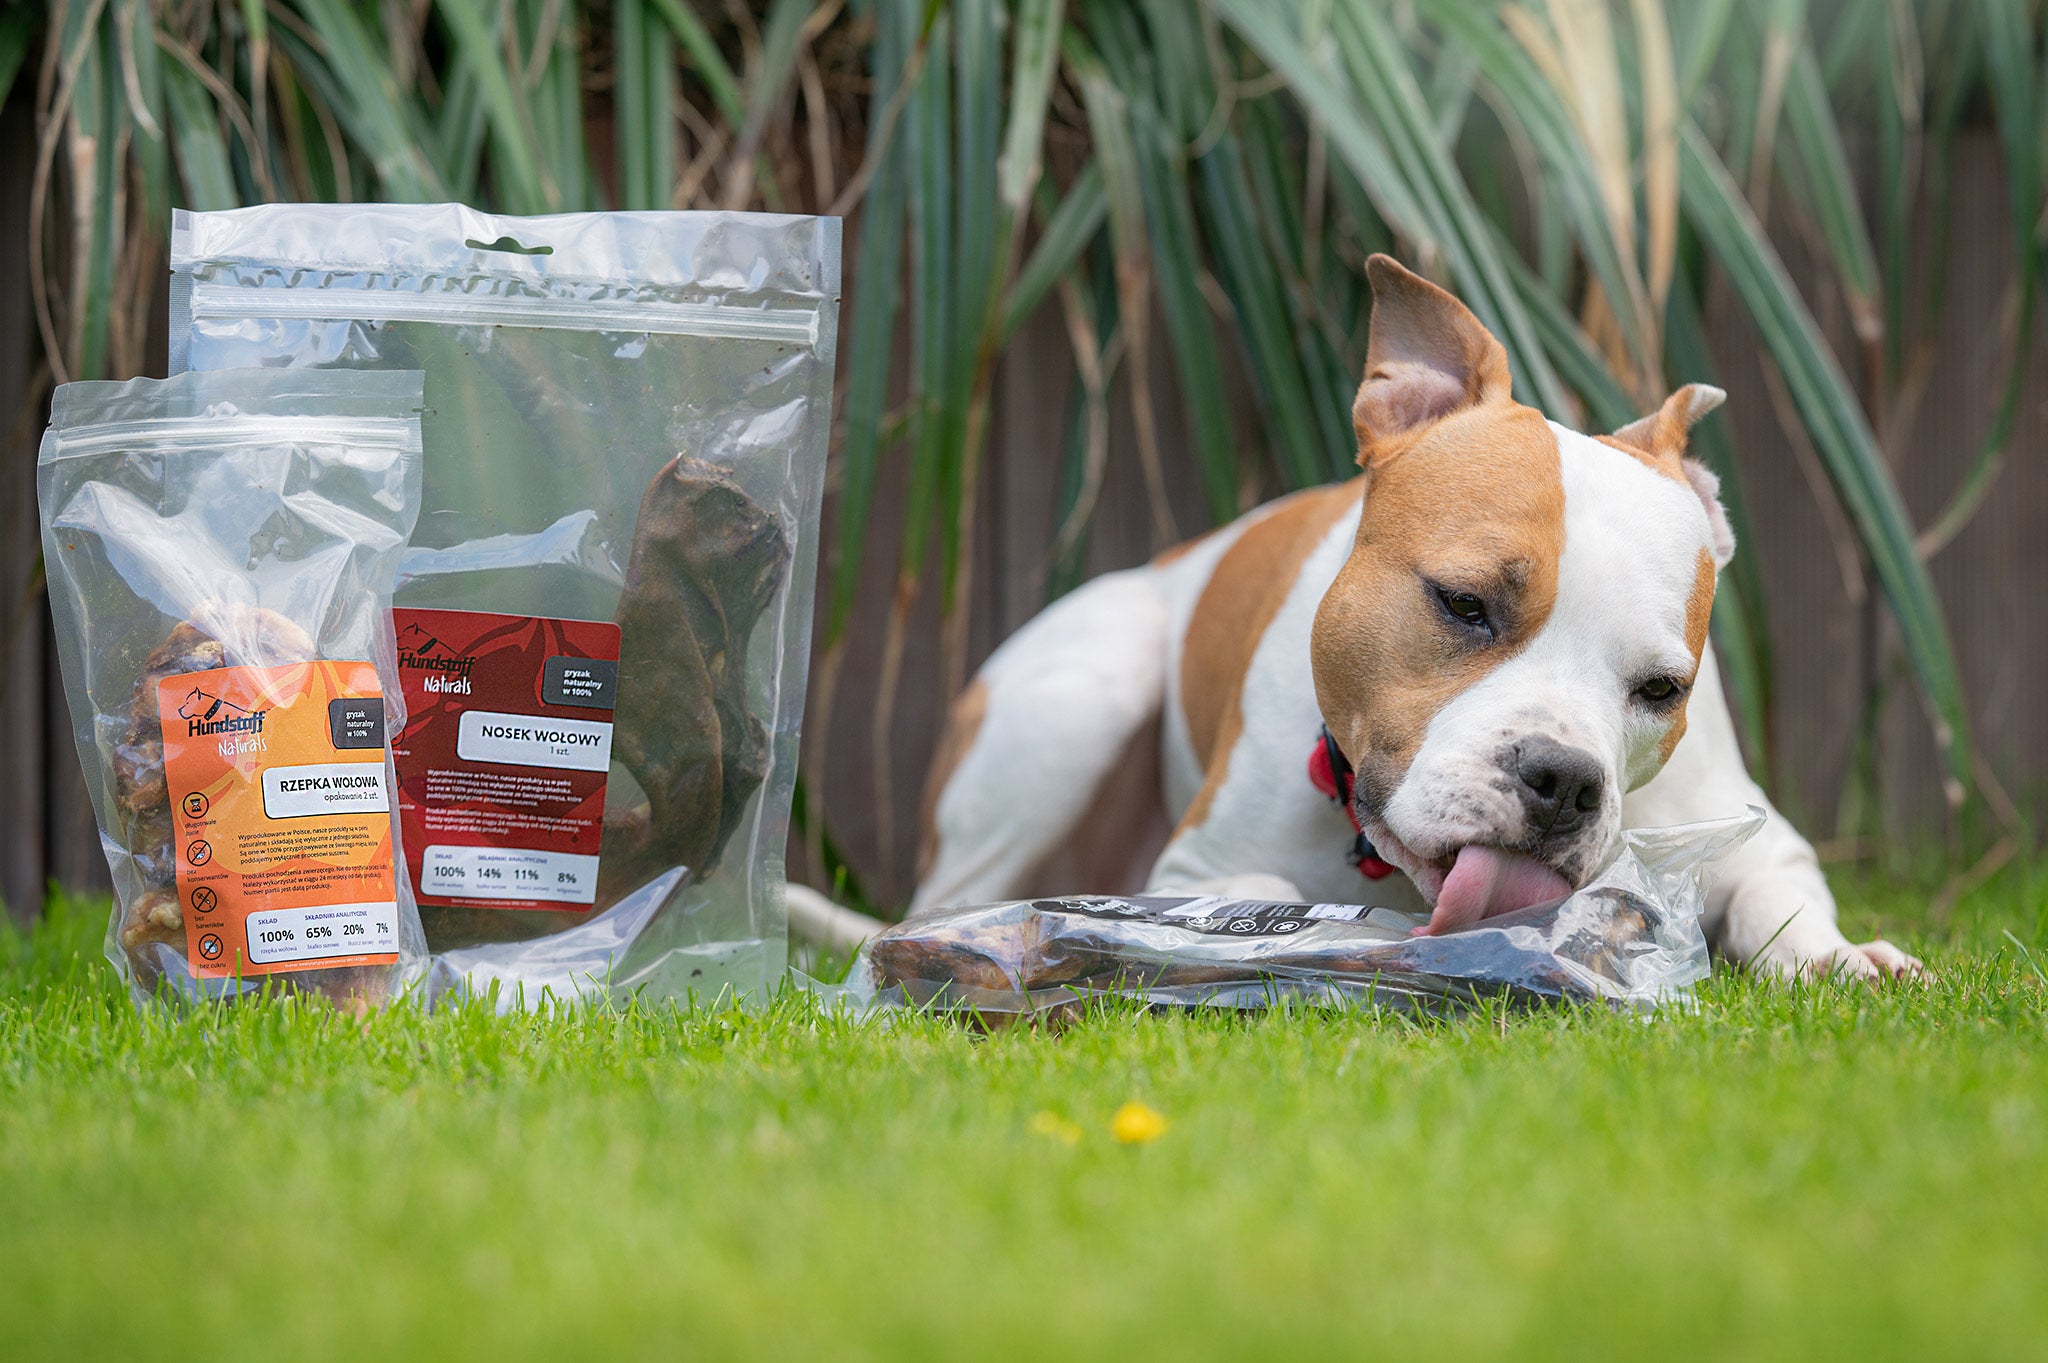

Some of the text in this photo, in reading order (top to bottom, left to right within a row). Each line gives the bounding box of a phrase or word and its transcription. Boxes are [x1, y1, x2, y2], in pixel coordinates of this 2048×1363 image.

[564, 669, 590, 678] gryzak
[424, 675, 471, 695] Naturals
[564, 678, 602, 690] naturalny
[572, 688, 592, 697] 100%
[346, 711, 365, 719] gryzak
[346, 720, 374, 729] naturalny
[482, 726, 601, 746] NOSEK WOŁOWY
[218, 736, 267, 757] Naturals
[280, 776, 378, 792] RZEPKA WOŁOWA
[324, 792, 362, 802] opakowanie
[369, 792, 378, 800] szt.
[238, 832, 286, 840] Wyprodukowane
[434, 866, 465, 877] 100%
[478, 868, 501, 878] 14%
[515, 869, 539, 880] 11%
[558, 873, 577, 883] 8%
[306, 926, 332, 938] 65%
[343, 924, 364, 935] 20%
[376, 923, 388, 933] 7%
[260, 930, 294, 942] 100%
